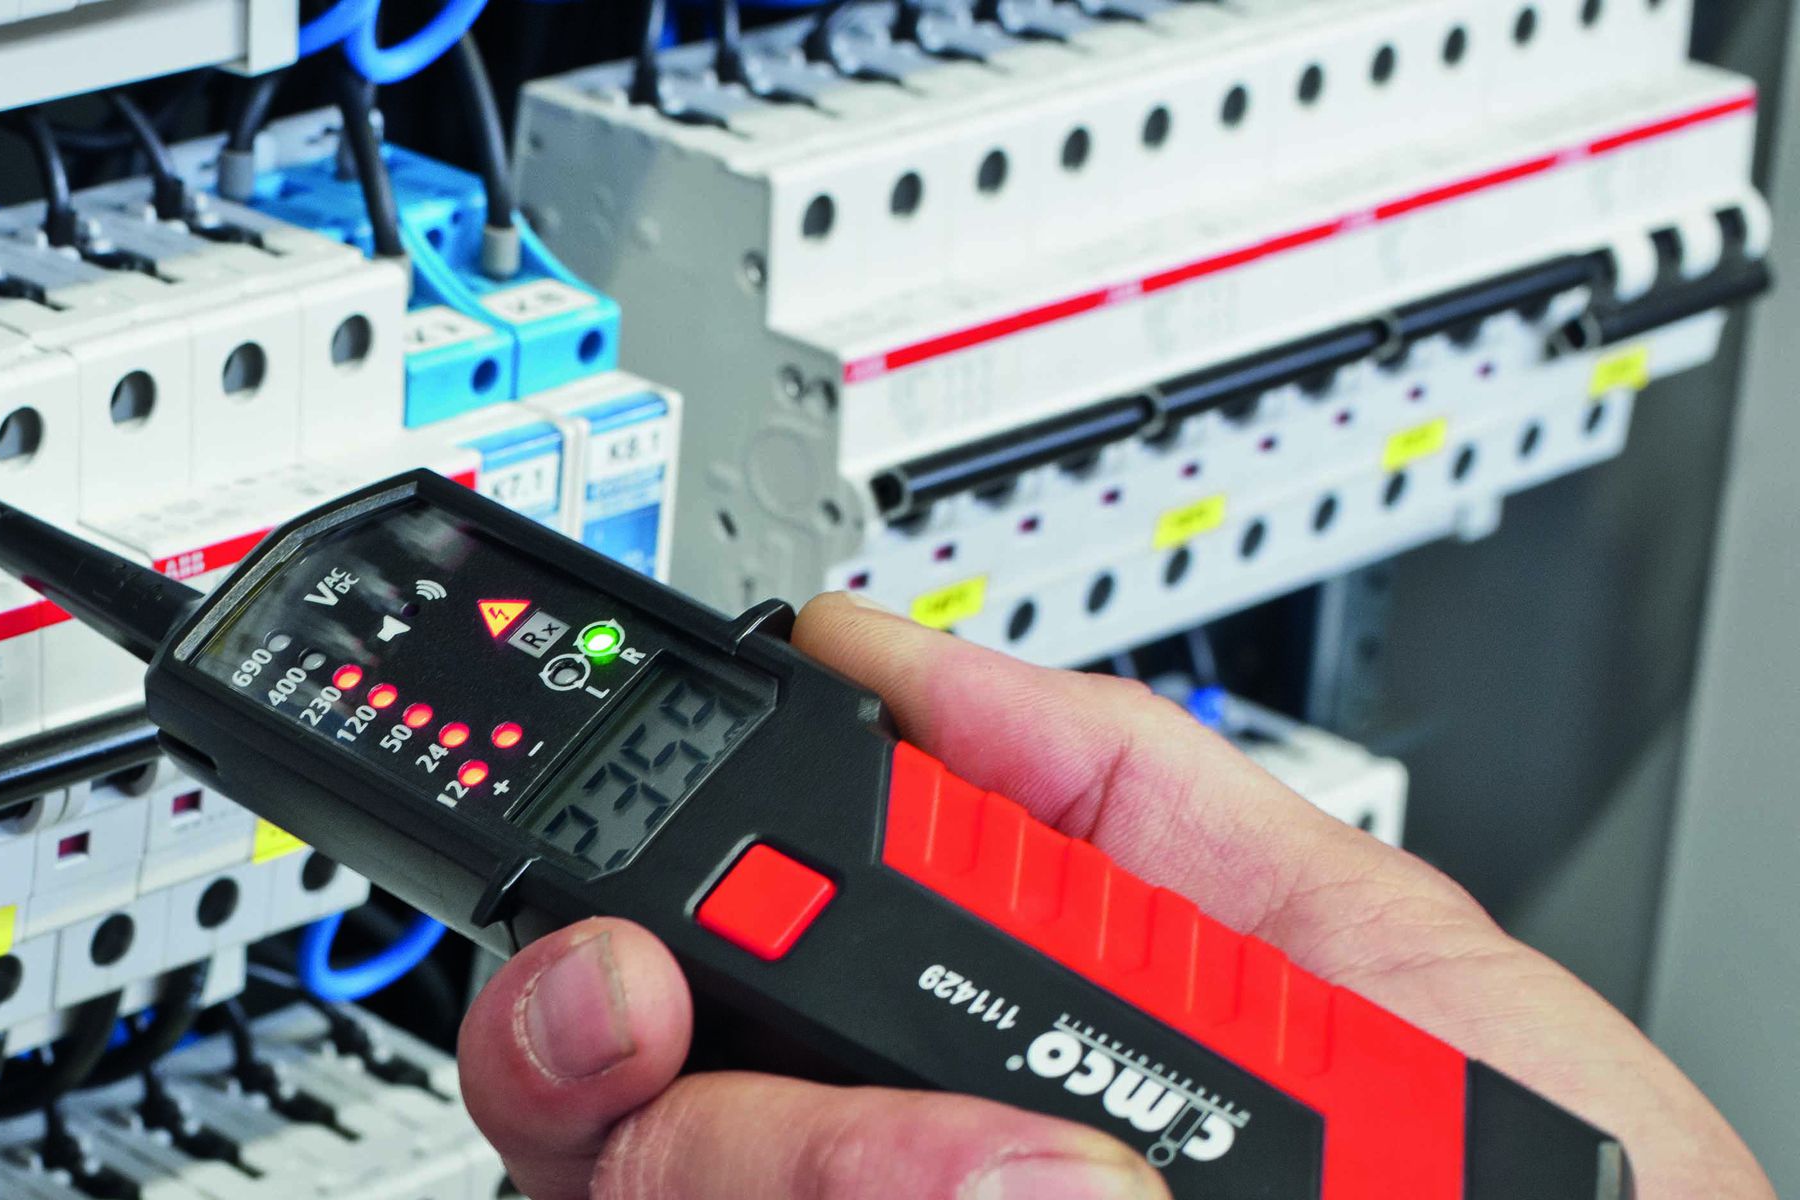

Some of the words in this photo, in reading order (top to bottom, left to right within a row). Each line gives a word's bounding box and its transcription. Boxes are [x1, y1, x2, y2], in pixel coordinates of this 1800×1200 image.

[232, 648, 272, 688] 690
[619, 647, 646, 666] R
[267, 667, 307, 706] 400
[585, 685, 610, 699] L
[300, 686, 342, 727] 230
[336, 704, 377, 742] 120
[380, 724, 413, 753] 50
[415, 743, 449, 773] 24
[436, 780, 469, 808] 12
[918, 964, 1020, 1030] 111429
